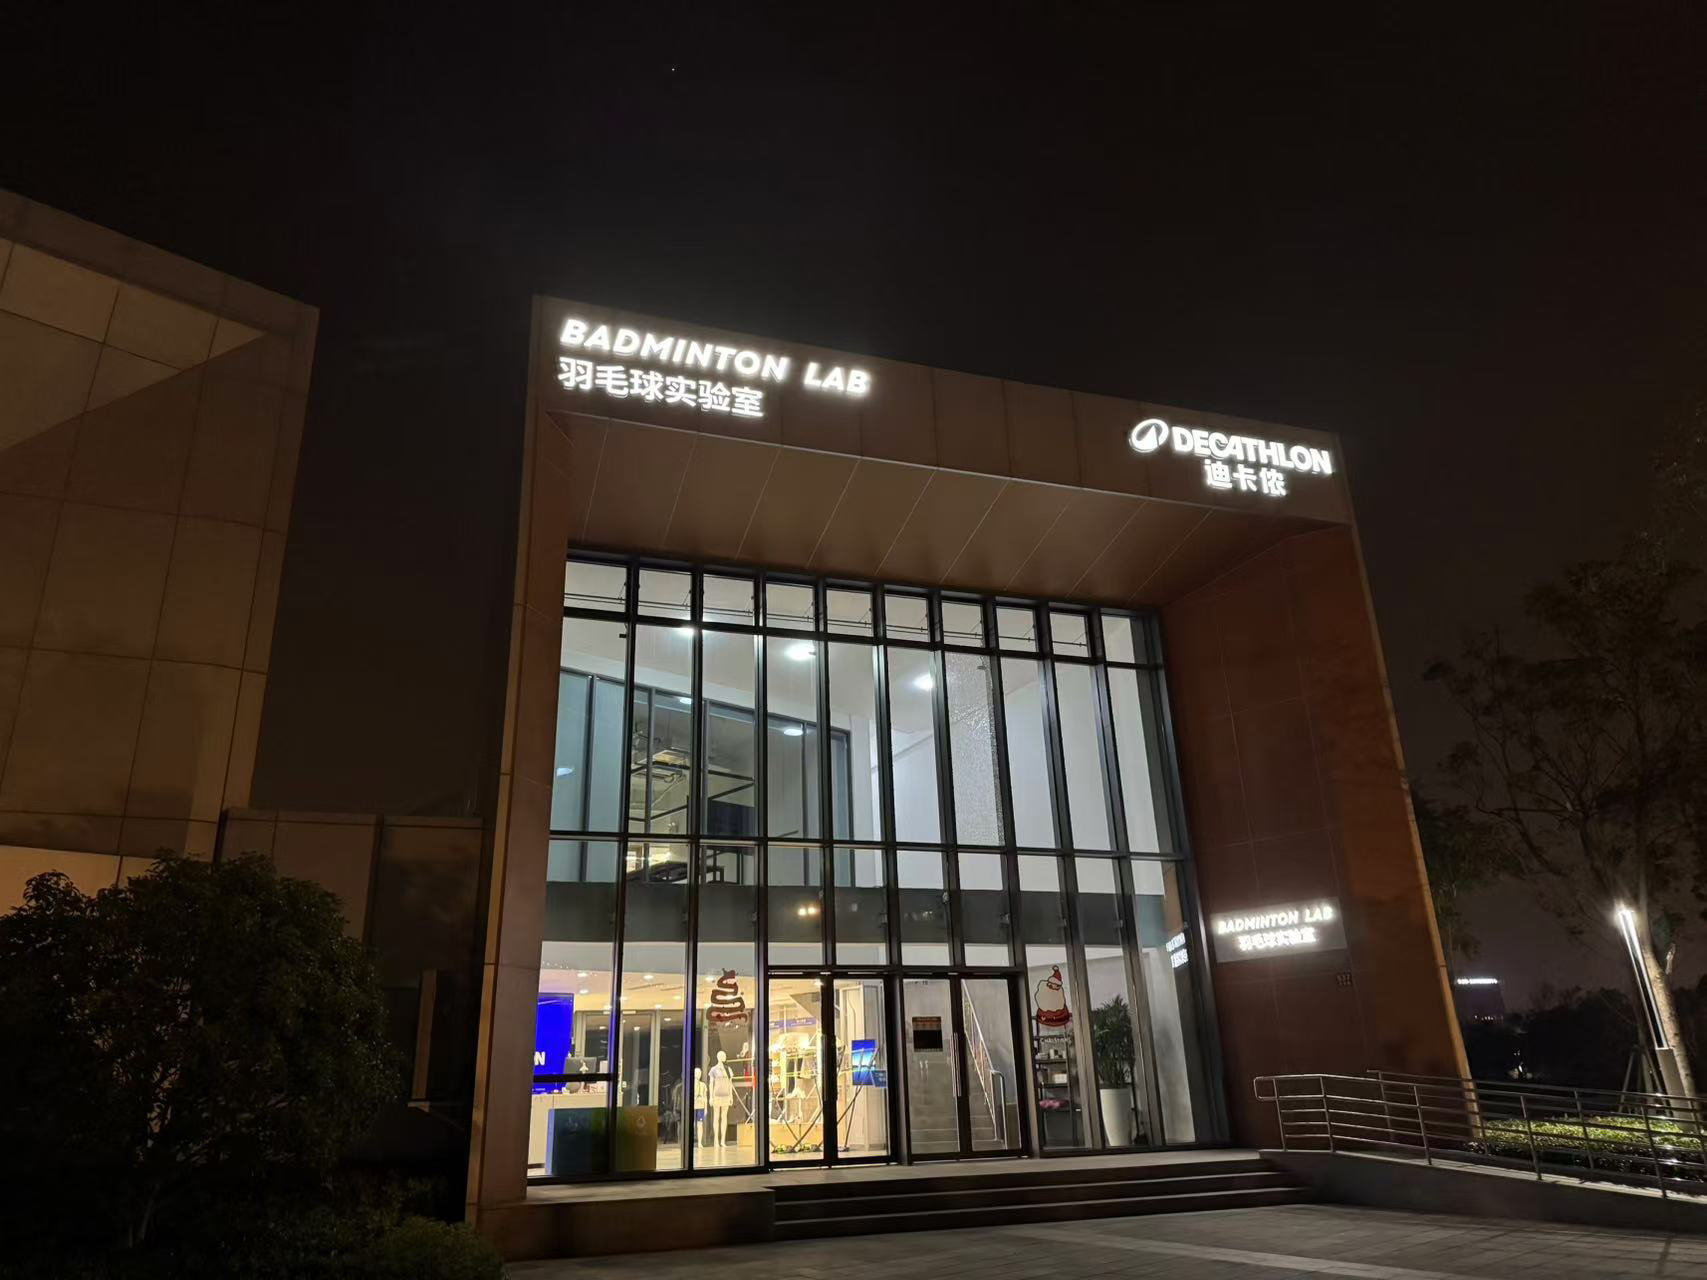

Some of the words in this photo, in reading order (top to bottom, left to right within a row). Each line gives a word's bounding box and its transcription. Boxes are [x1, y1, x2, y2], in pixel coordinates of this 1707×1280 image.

[559, 318, 790, 382] BADMINTON
[803, 361, 871, 395] LAB
[556, 356, 765, 418] 羽毛球实验室
[1171, 426, 1334, 475] DECATHLON
[1203, 458, 1288, 497] 迪卡侬
[1217, 909, 1299, 935] BADMINTON
[1304, 905, 1334, 923] LAB
